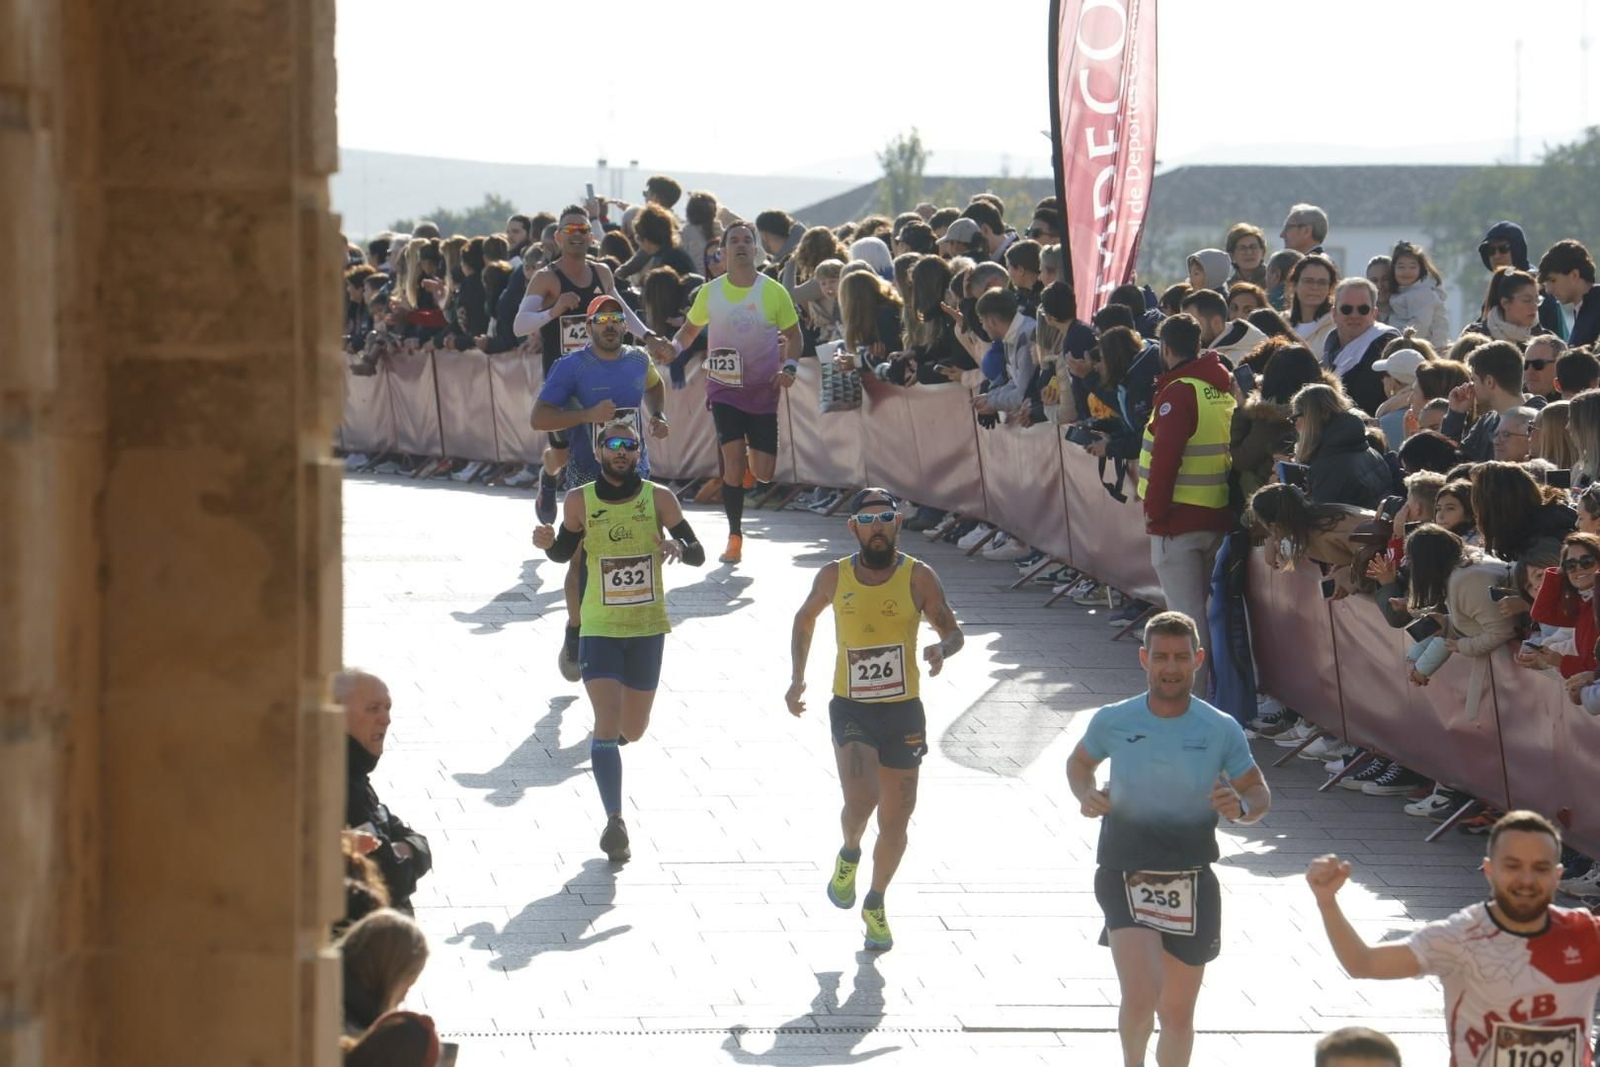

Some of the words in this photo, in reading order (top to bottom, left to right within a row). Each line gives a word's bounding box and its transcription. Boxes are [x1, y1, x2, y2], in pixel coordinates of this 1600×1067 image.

[1126, 187, 1143, 214] de
[709, 358, 736, 371] 1123
[611, 569, 645, 586] 632
[857, 661, 894, 681] 226
[1140, 887, 1181, 909] 258
